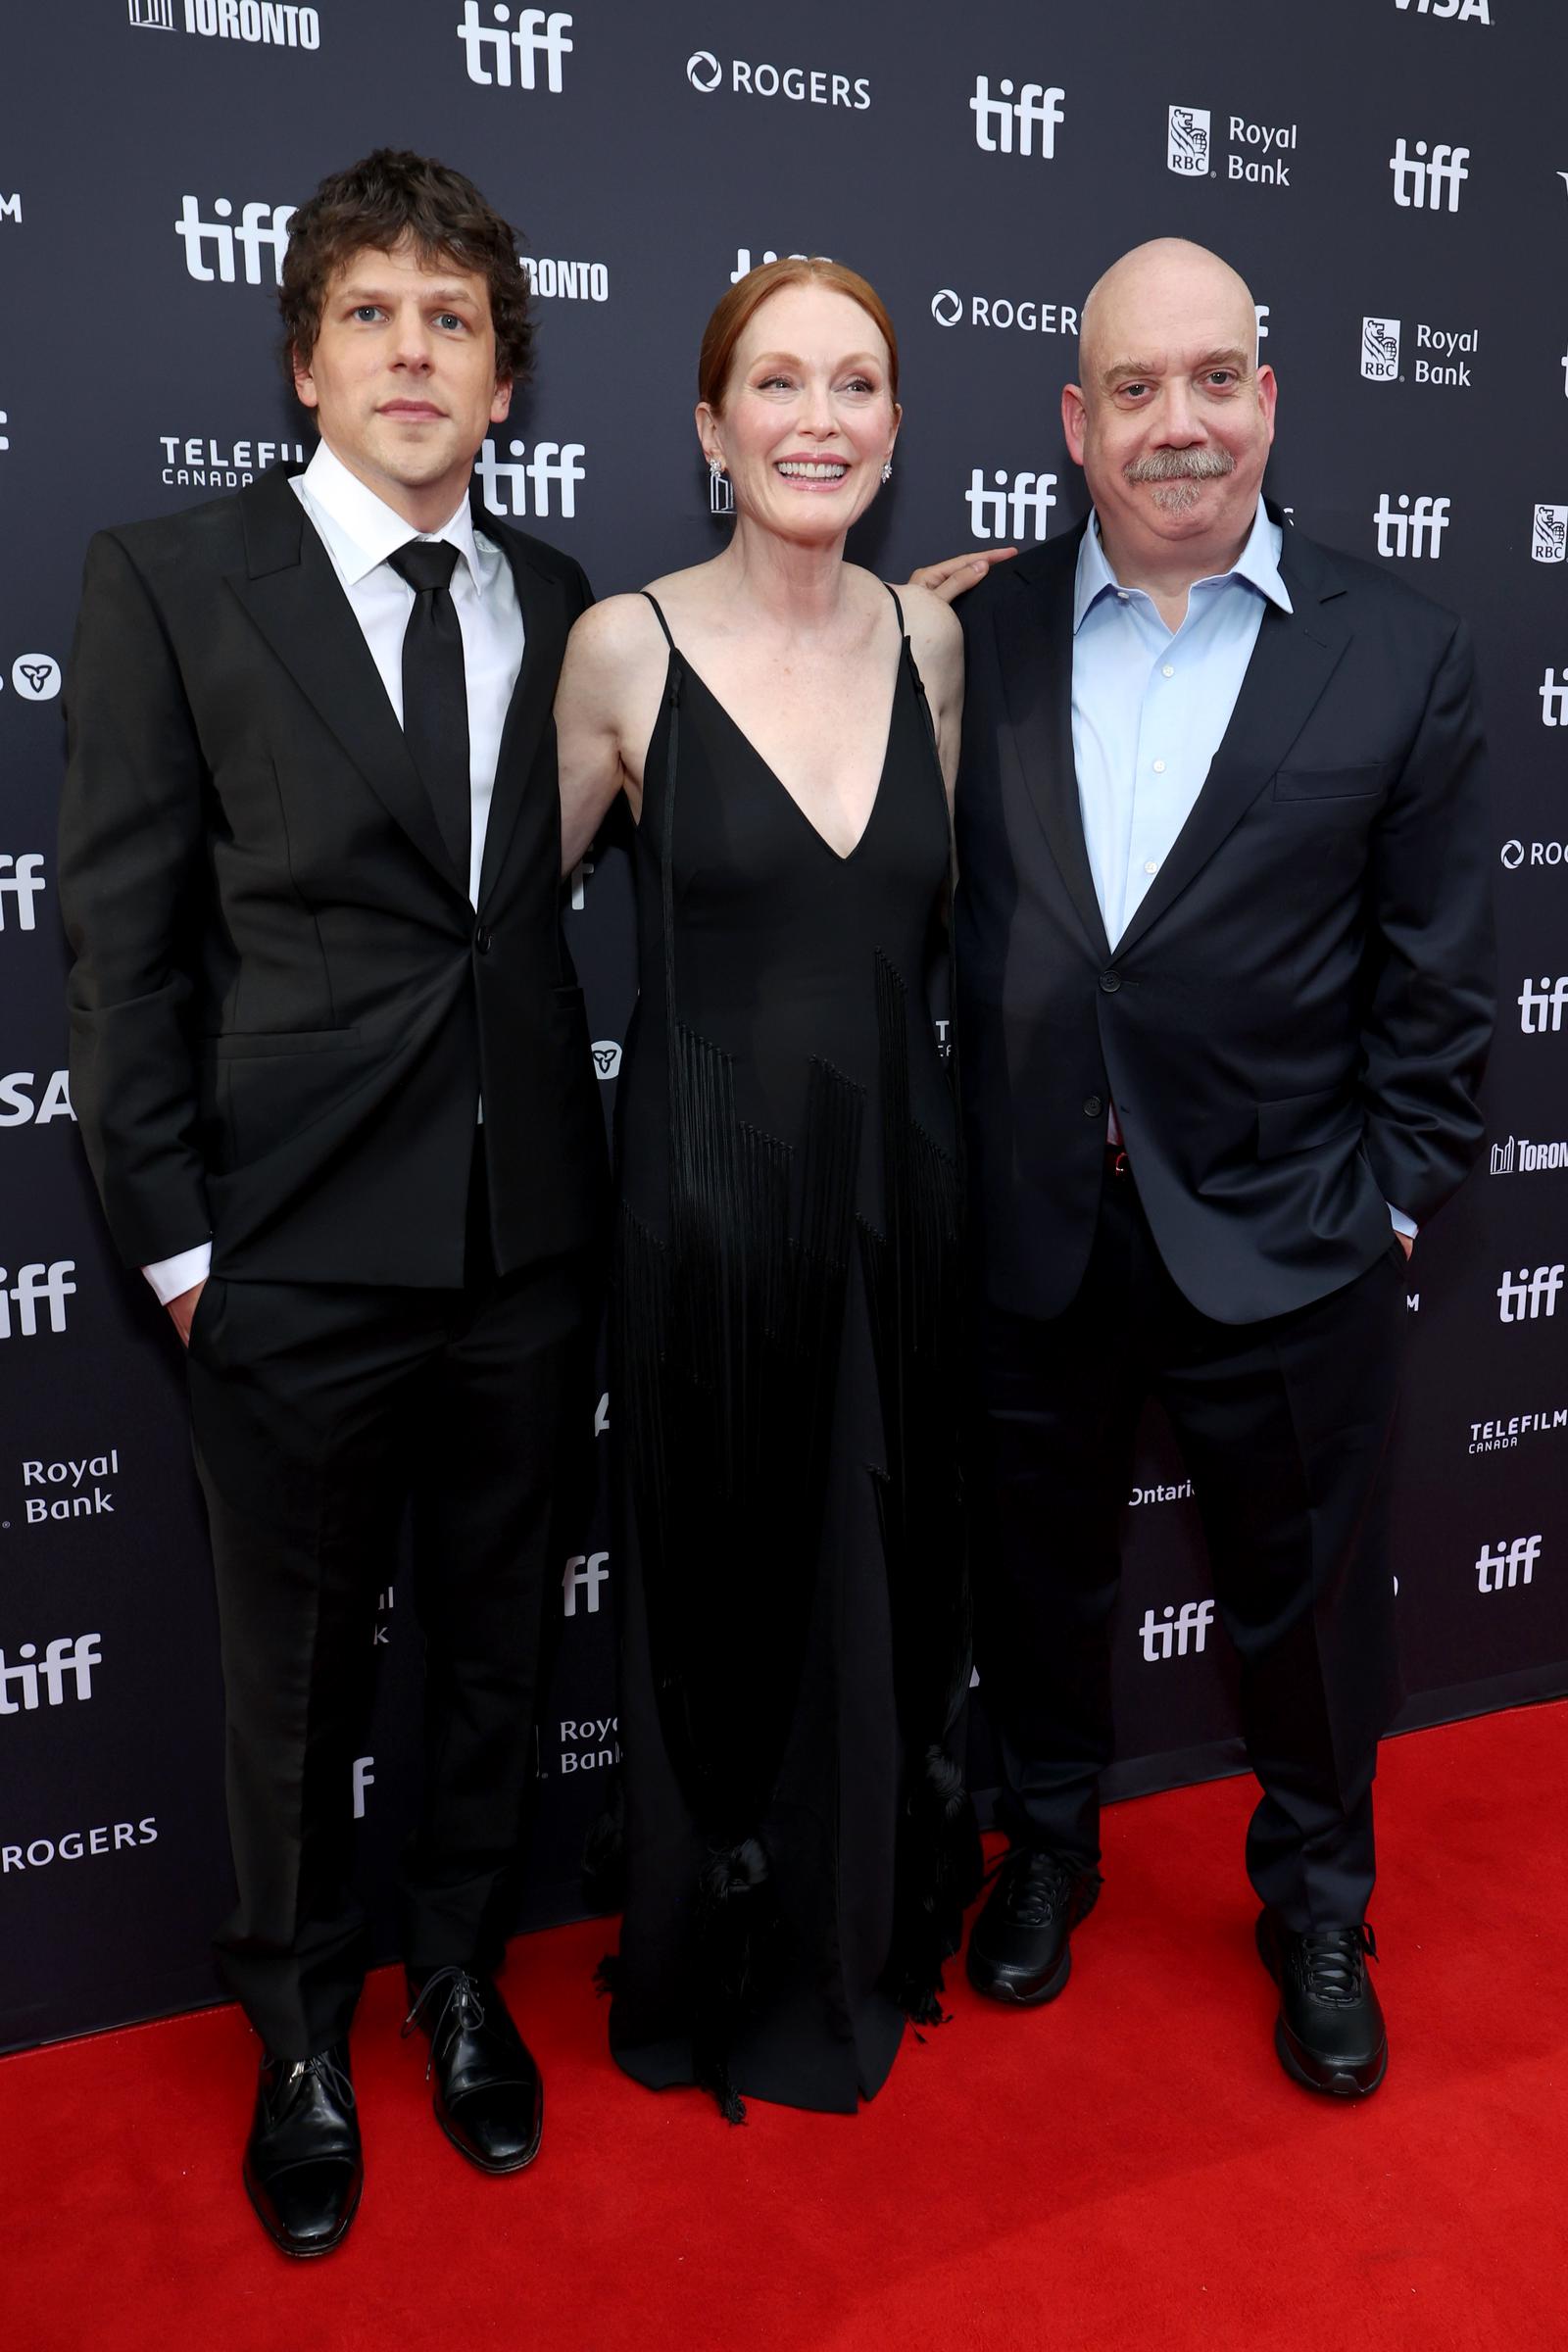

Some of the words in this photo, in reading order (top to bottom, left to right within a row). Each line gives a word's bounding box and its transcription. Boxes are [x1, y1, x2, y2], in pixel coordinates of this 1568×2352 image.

[458, 0, 573, 93] tiff
[733, 60, 871, 110] ROGERS
[970, 75, 1065, 159] tiff
[1229, 116, 1298, 154] Royal
[1172, 154, 1205, 172] RBC
[1228, 154, 1291, 186] Bank
[1390, 138, 1470, 213] tiff
[973, 297, 1083, 336] ROGER
[1417, 324, 1479, 358] Royal
[1365, 362, 1396, 377] RBC
[1415, 360, 1471, 387] Bank
[474, 439, 586, 518] tiff
[965, 468, 1057, 540] tiff
[1373, 494, 1450, 560] tiff
[1536, 545, 1563, 559] RBC
[1496, 1264, 1565, 1323] tiff
[1470, 1409, 1568, 1442] TELEFILM
[1468, 1437, 1518, 1454] CANADA
[23, 1449, 119, 1489] Royal
[25, 1488, 115, 1524] Bank
[1128, 1479, 1196, 1506] Ontari
[1475, 1535, 1543, 1593] tiff
[1139, 1599, 1215, 1662] tiff
[1, 1817, 158, 1873] ROGERS
